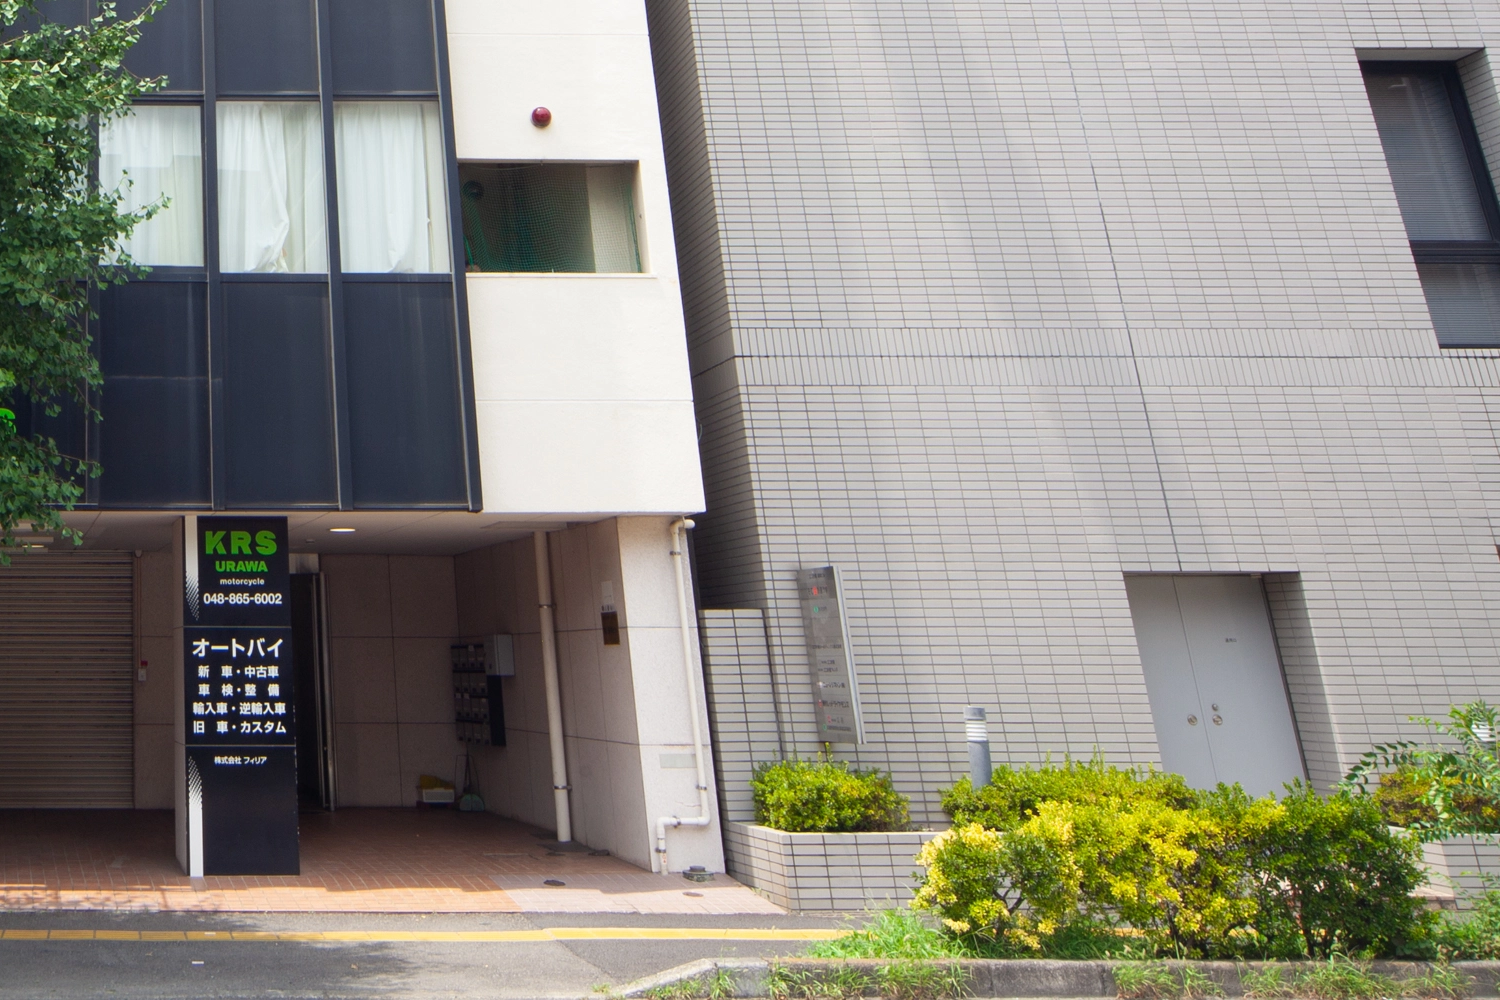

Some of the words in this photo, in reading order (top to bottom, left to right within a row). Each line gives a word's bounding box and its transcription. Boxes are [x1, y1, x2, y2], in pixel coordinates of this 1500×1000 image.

[205, 530, 278, 556] KRS
[215, 560, 269, 573] URAWA
[219, 577, 265, 587] motorcycle
[203, 592, 283, 605] 048-865-6002
[192, 638, 284, 658] オートバイ
